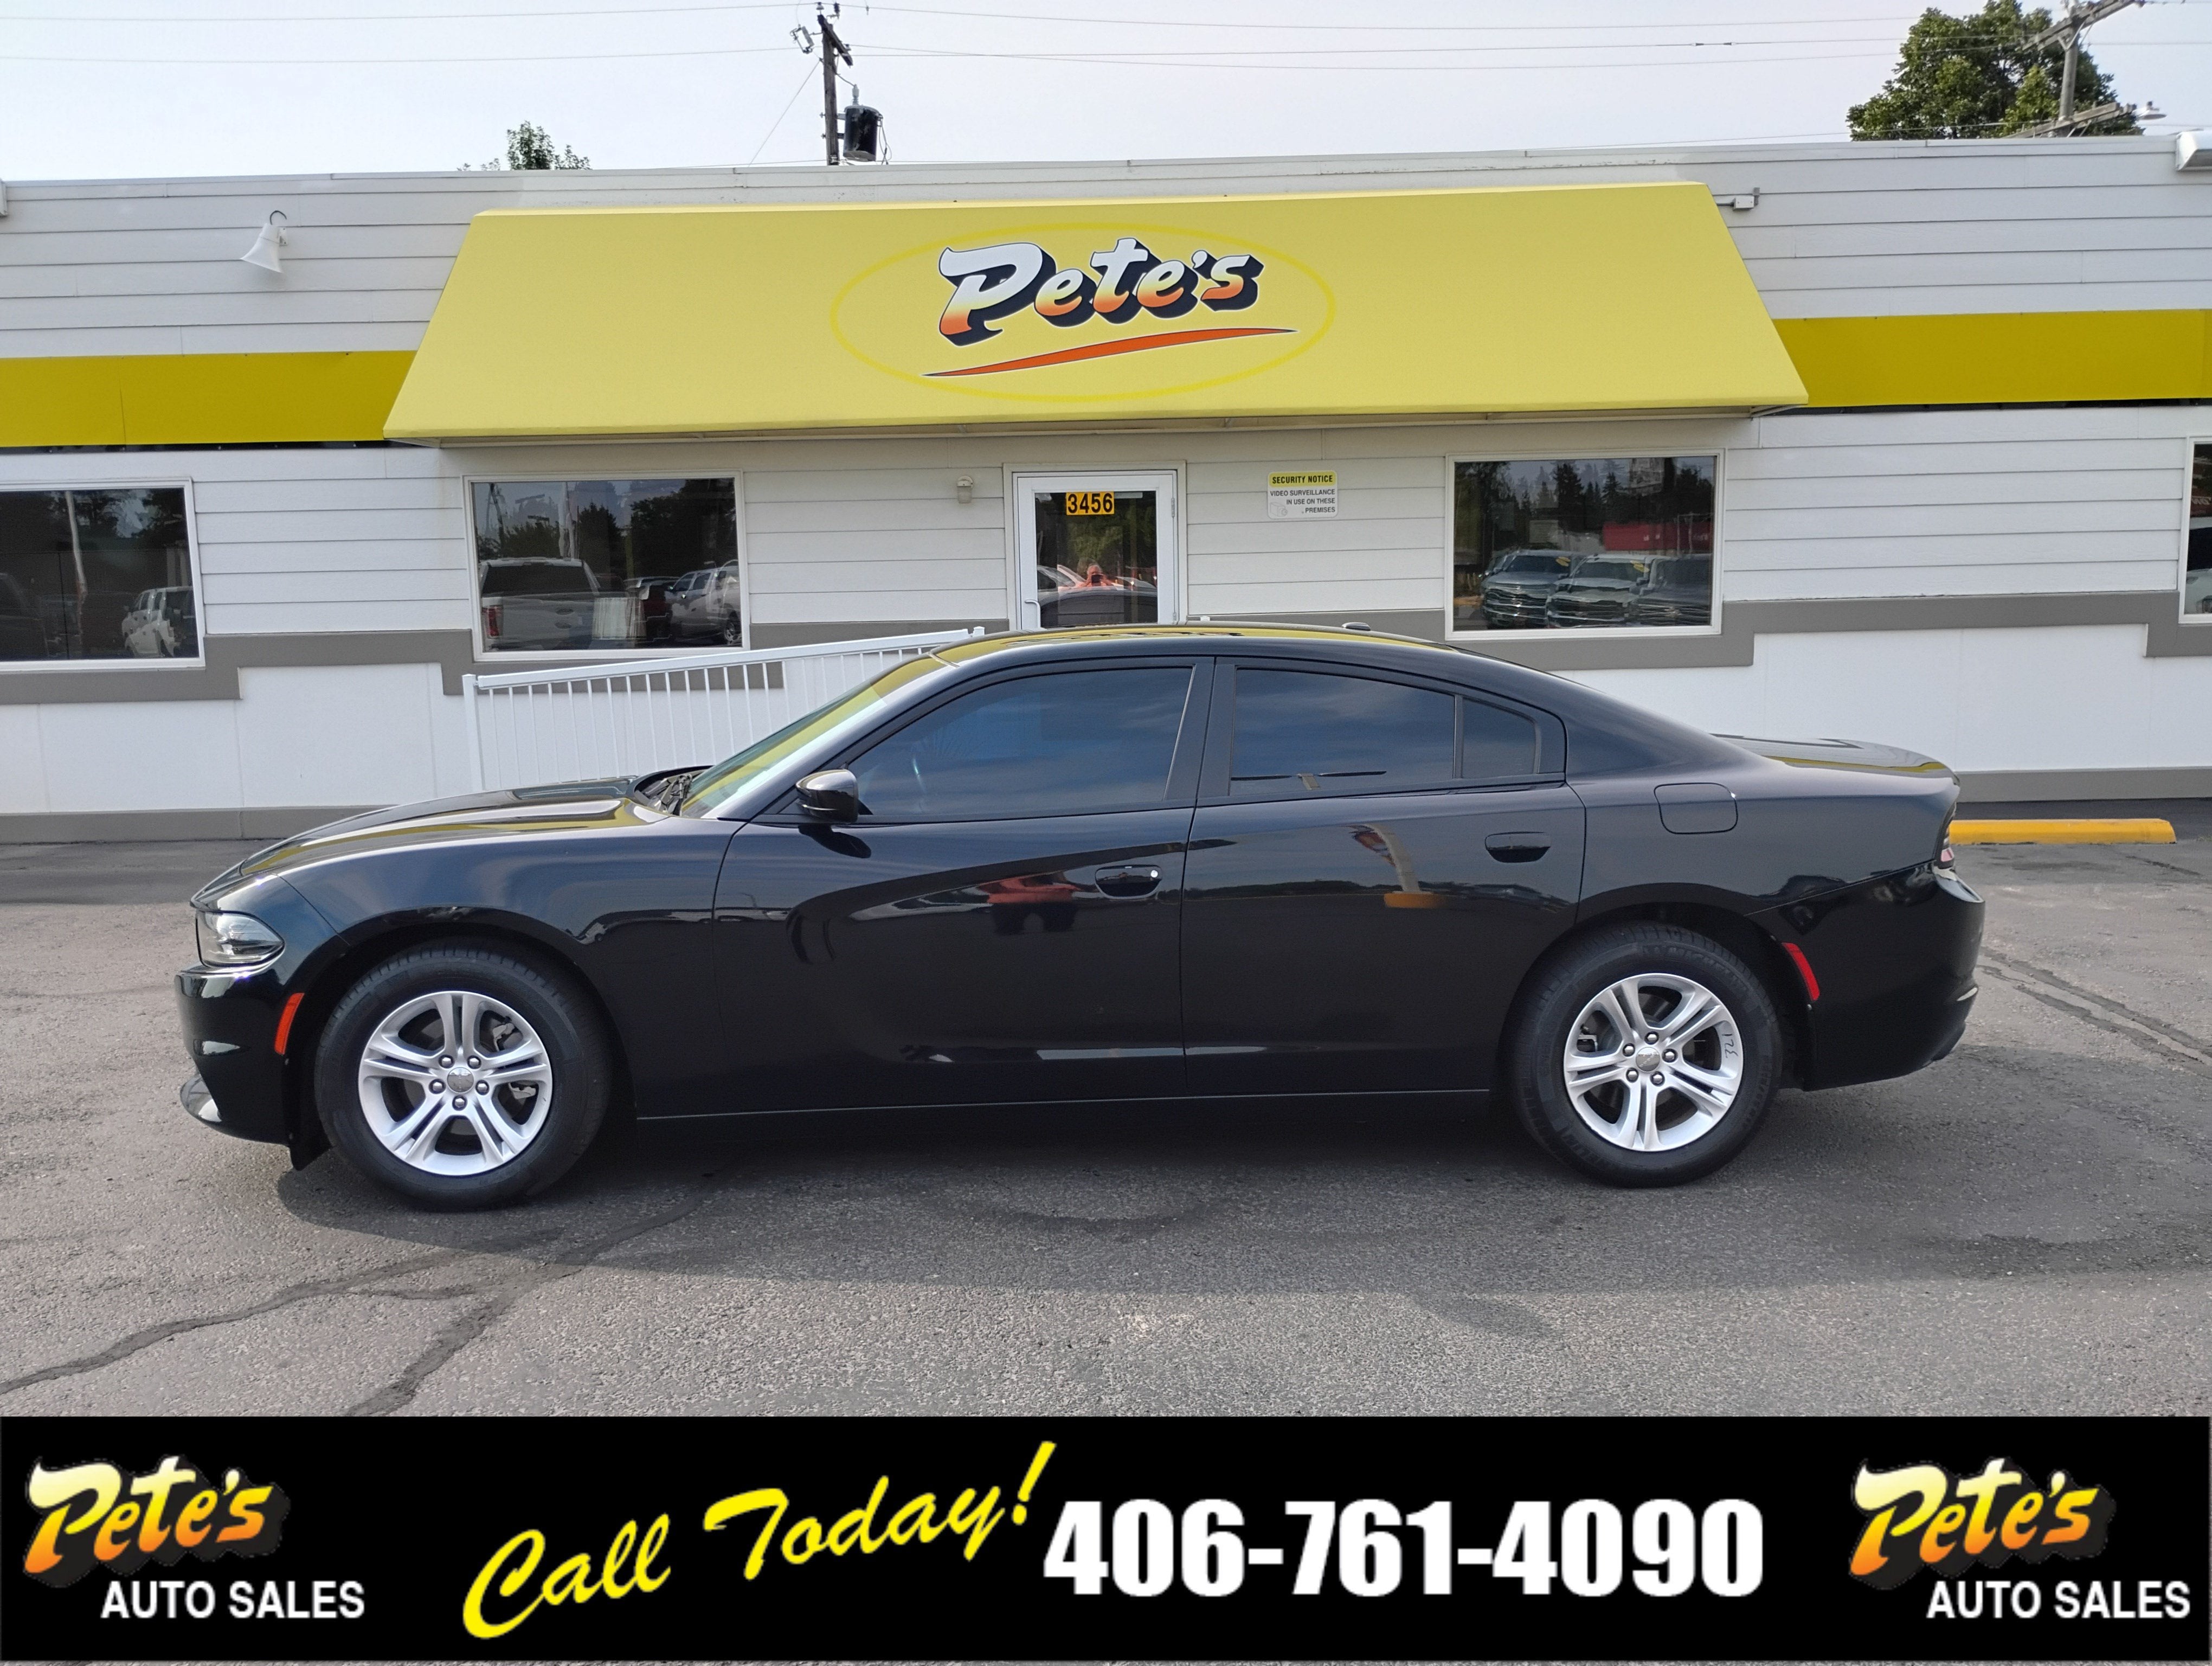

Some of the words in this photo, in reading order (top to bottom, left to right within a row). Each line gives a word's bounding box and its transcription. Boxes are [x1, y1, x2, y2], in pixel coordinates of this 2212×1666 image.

[938, 237, 1264, 345] Pete's
[1272, 476, 1306, 484] SECURITY
[1308, 475, 1333, 483] NOTICE
[1067, 492, 1113, 514] 3456
